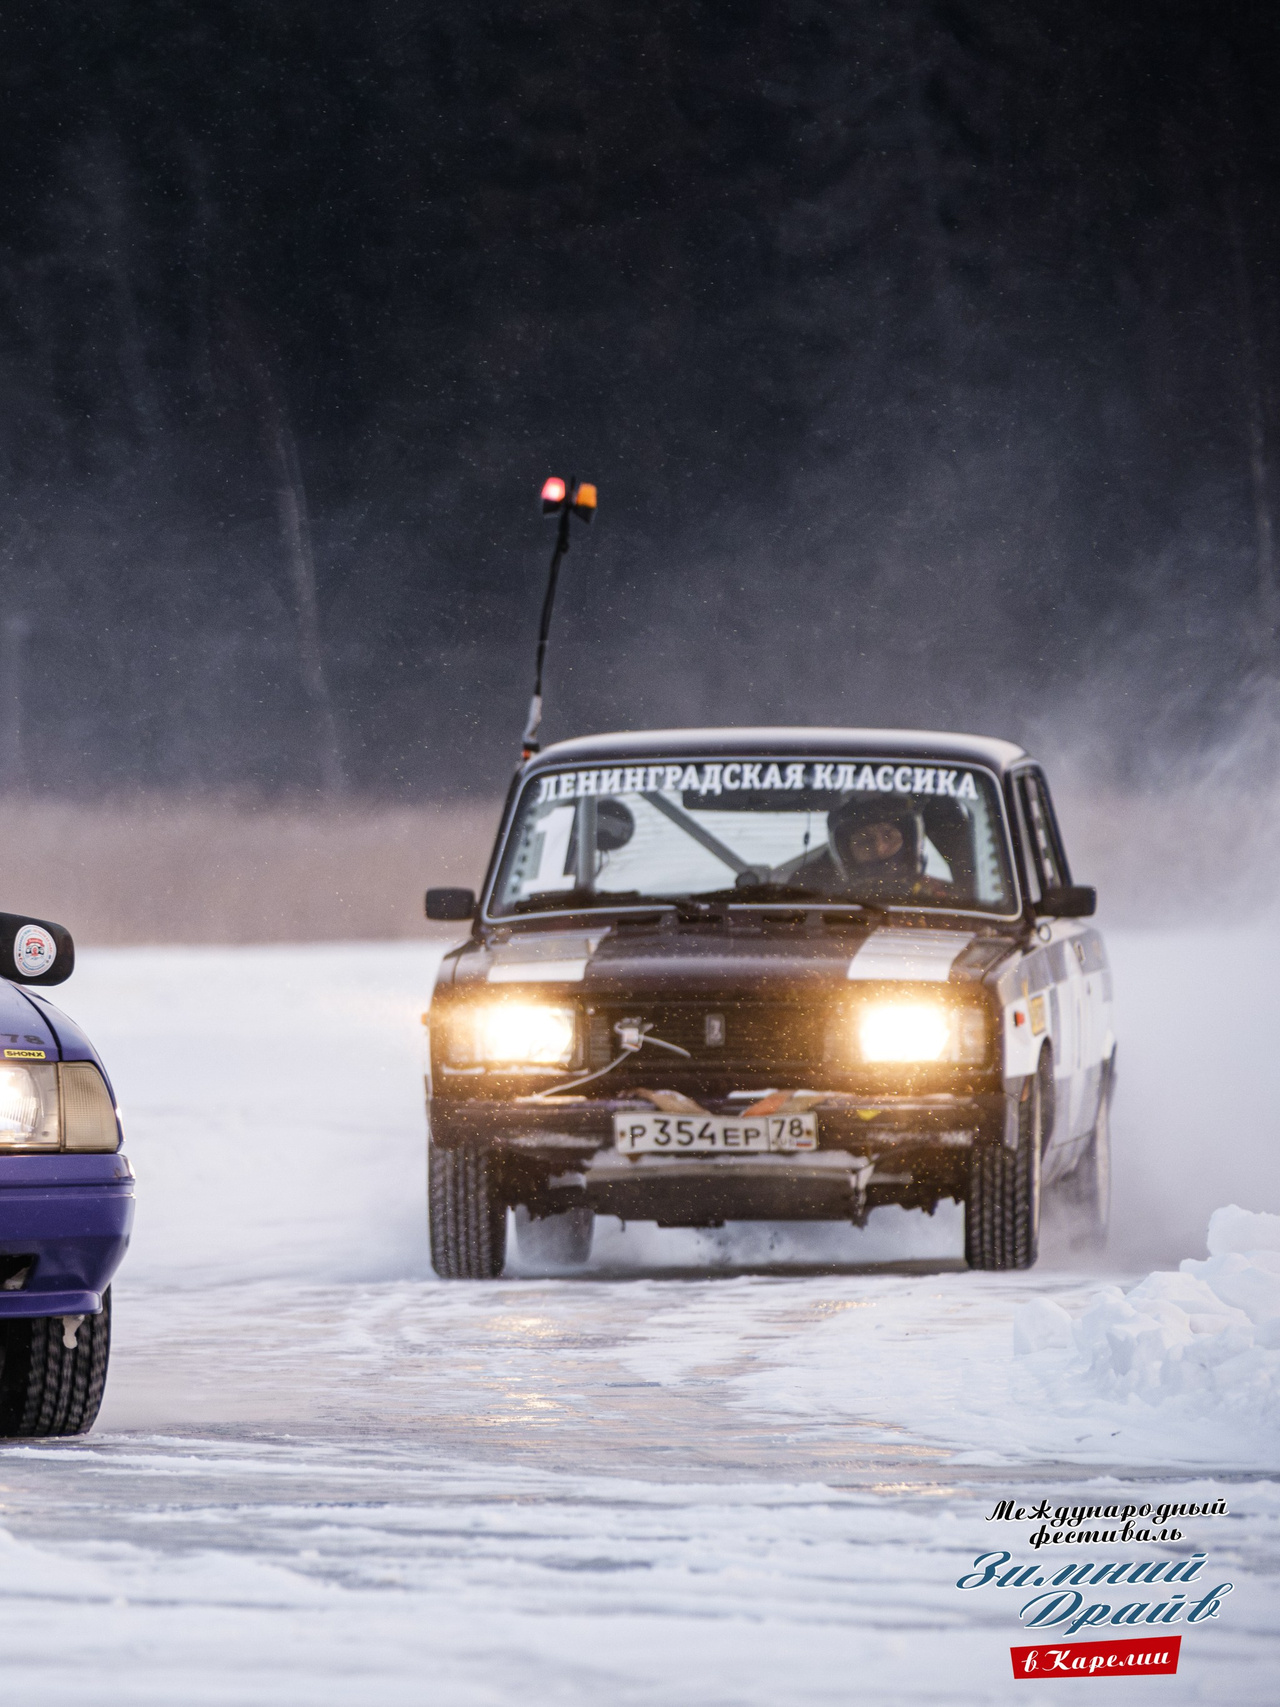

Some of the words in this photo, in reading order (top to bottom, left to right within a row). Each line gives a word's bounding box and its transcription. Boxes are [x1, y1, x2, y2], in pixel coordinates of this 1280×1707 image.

[539, 763, 804, 802] ЛЕНИНГРАДСКАЯ
[814, 764, 979, 799] КЛАССИКА
[6, 1050, 45, 1058] SHONX
[771, 1118, 804, 1139] 78
